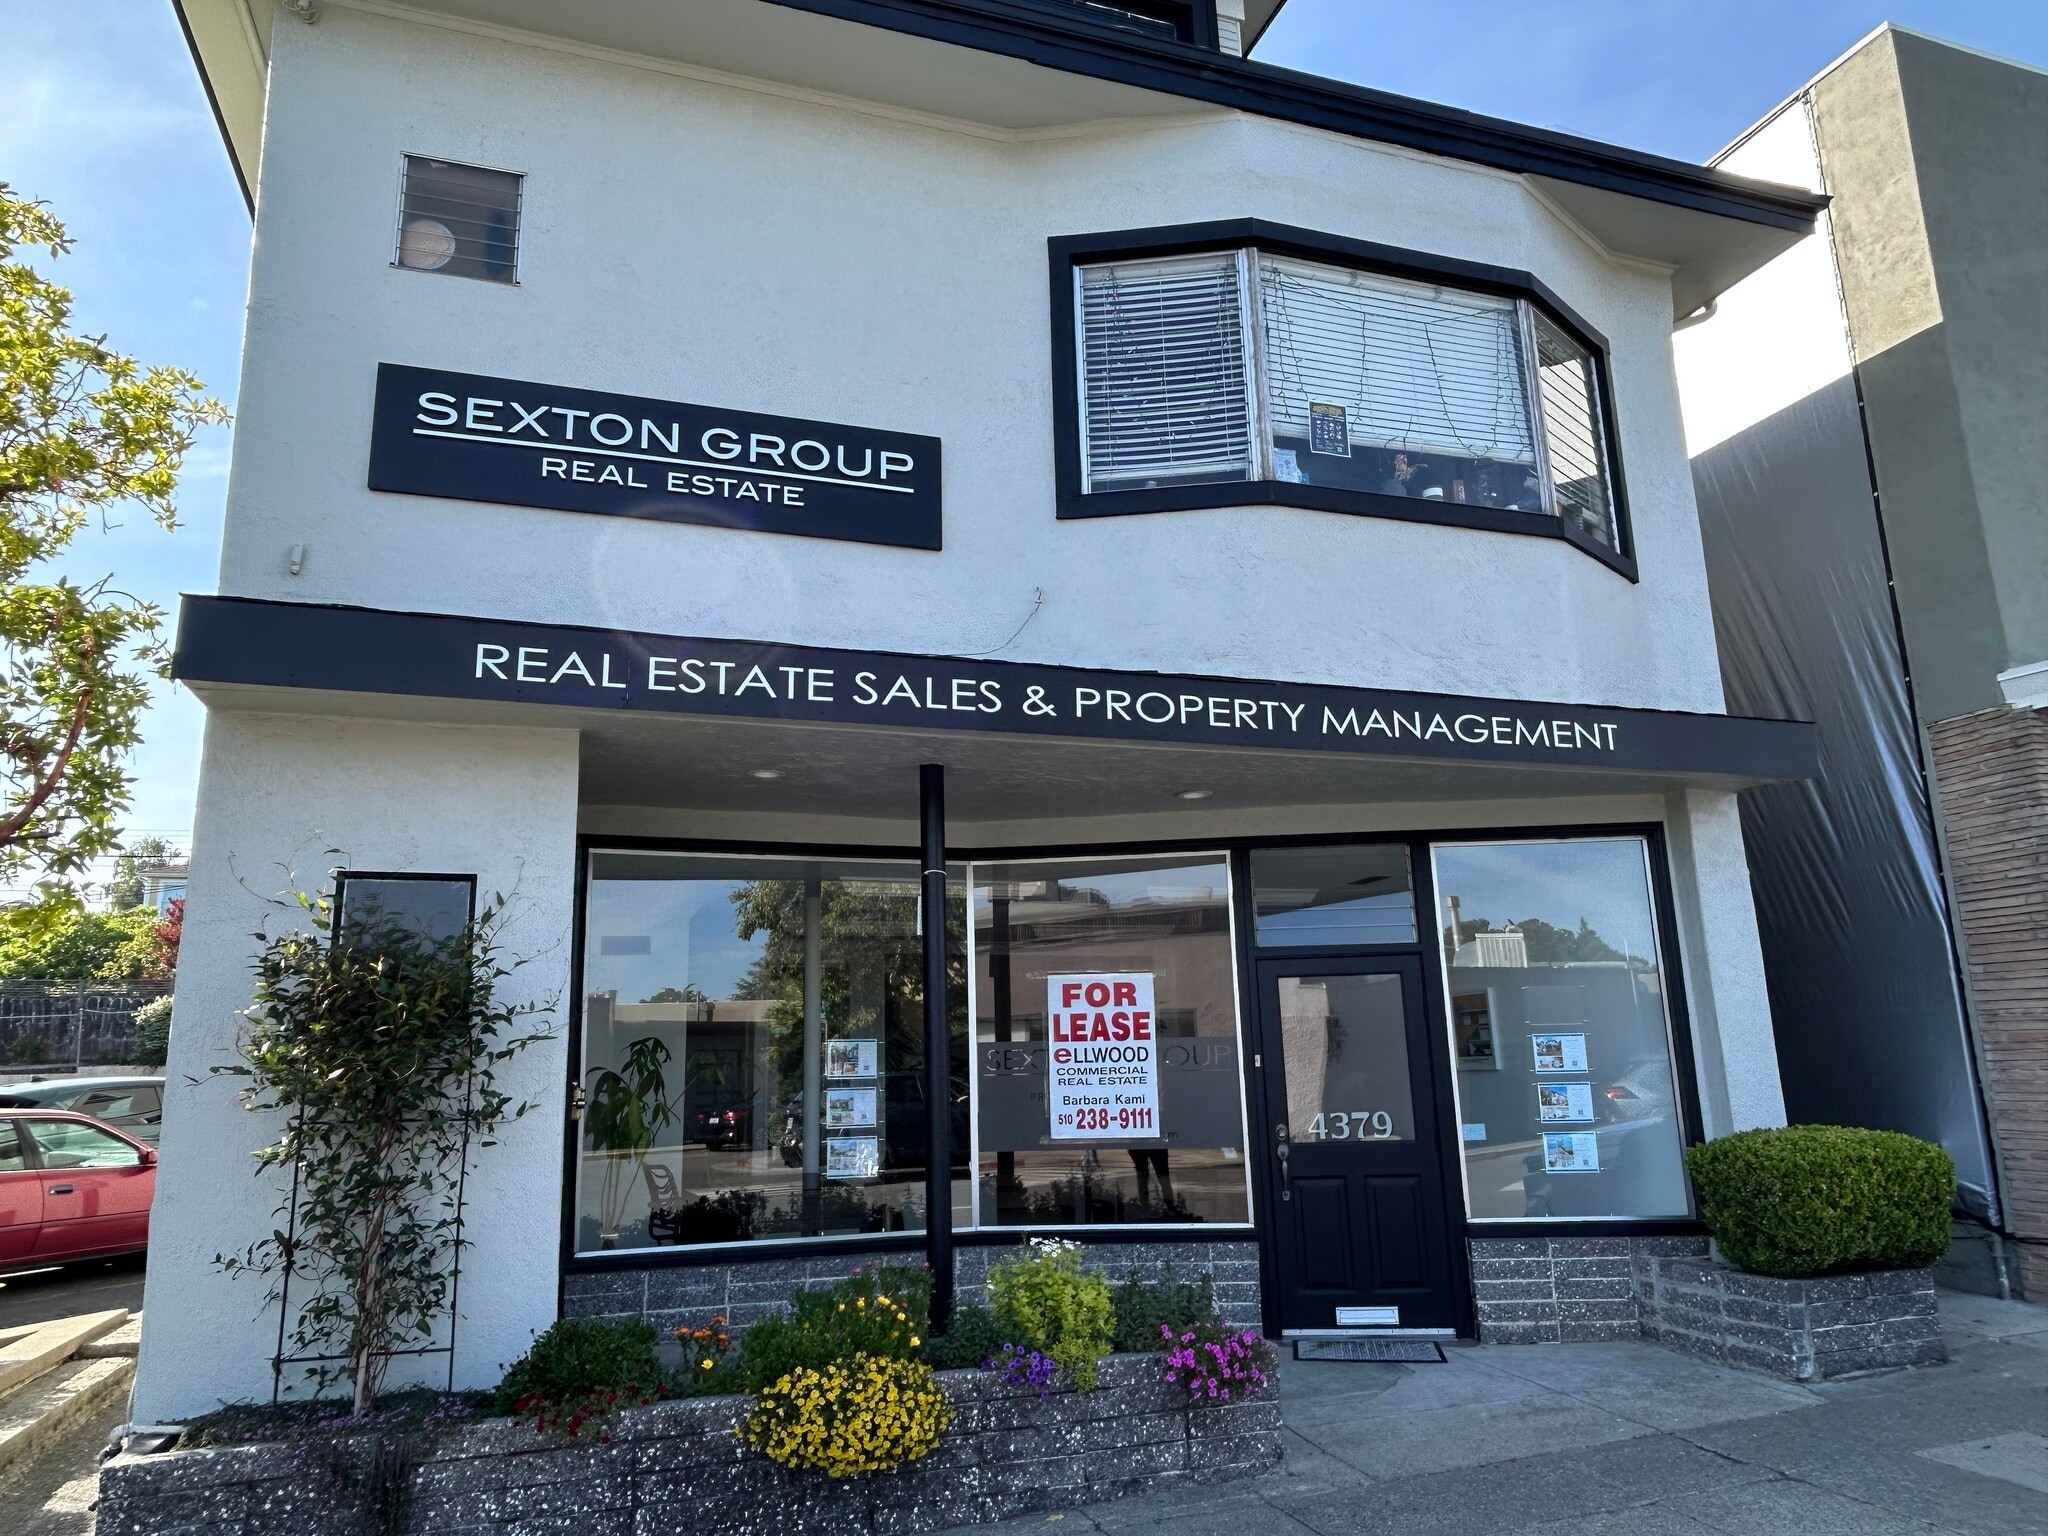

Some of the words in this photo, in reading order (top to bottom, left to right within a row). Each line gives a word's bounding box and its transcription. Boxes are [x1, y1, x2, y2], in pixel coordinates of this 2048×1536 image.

[416, 391, 680, 453] SEXTON
[701, 427, 914, 480] GROUP
[541, 457, 648, 488] REAL
[667, 471, 805, 507] ESTATE
[475, 643, 627, 689] REAL
[648, 656, 834, 702] ESTATE
[852, 671, 1002, 713] SALES
[1022, 685, 1057, 717] &
[1075, 687, 1305, 732] PROPERTY
[1322, 705, 1618, 751] MANAGEMENT
[1061, 982, 1137, 1008] FOR
[1053, 1011, 1151, 1042] LEASE
[1056, 1066, 1148, 1076] COMMERCIAL
[1058, 1077, 1093, 1086] REAL
[1098, 1076, 1147, 1086] ESTATE
[1063, 1095, 1110, 1106] Barbara
[1115, 1094, 1146, 1105] Kami
[1058, 1113, 1073, 1126] 510
[1076, 1107, 1152, 1129] 238-9111
[1308, 1111, 1393, 1140] 4379
